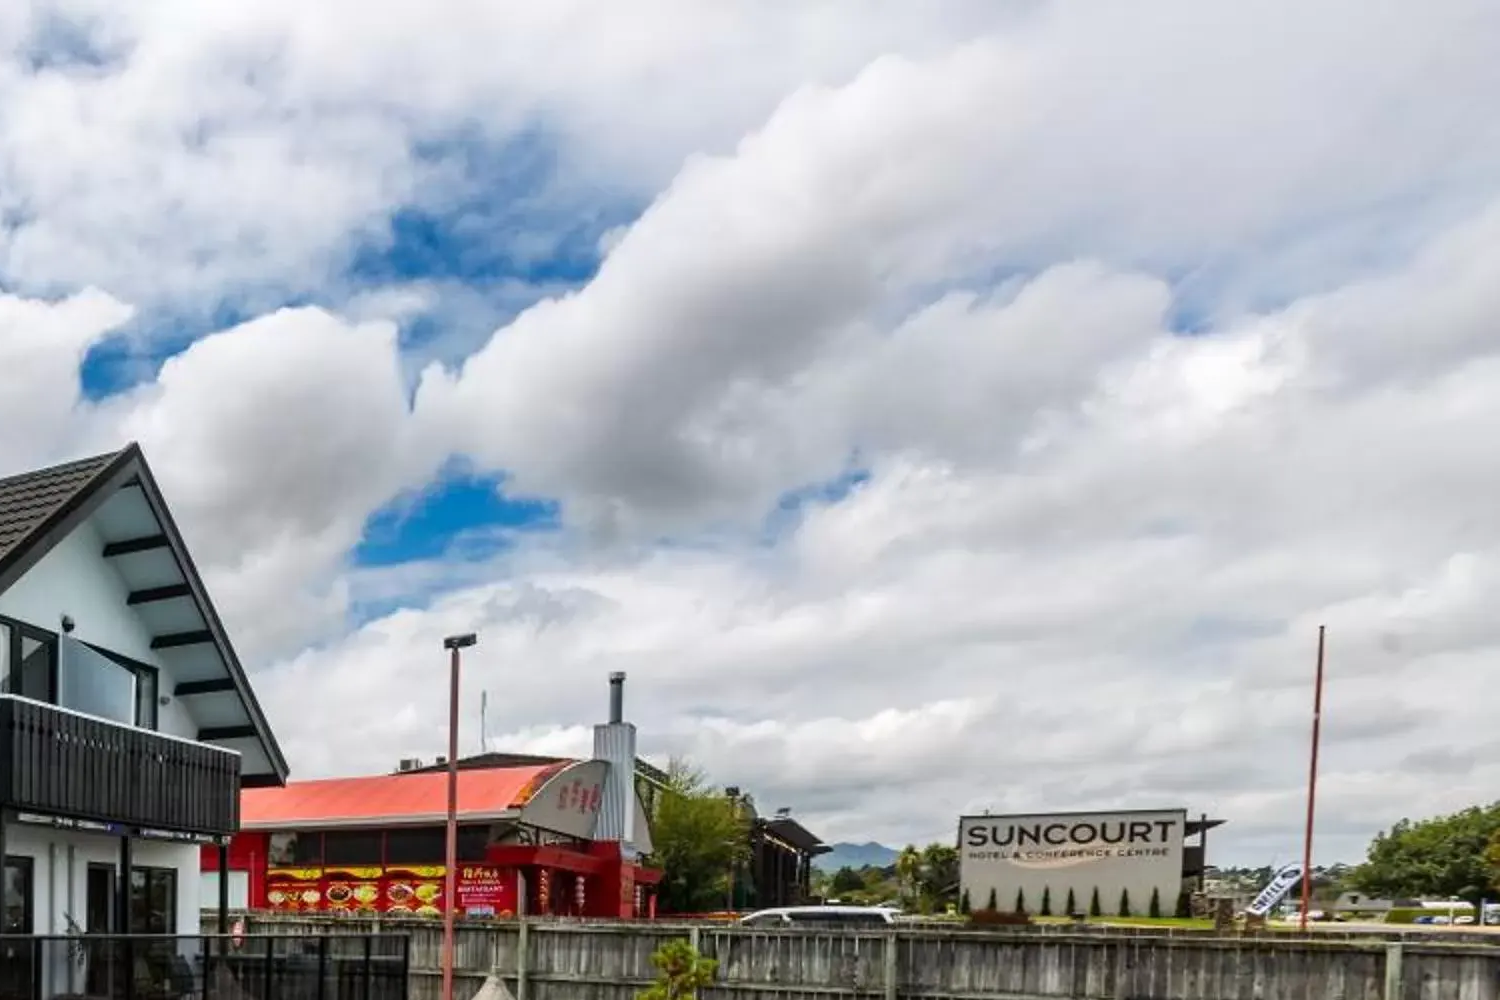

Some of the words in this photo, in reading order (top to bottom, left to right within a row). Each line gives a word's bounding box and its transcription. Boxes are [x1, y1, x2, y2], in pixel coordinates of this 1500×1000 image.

[967, 821, 1176, 847] SUNCOURT
[968, 851, 1008, 860] HOTEL
[1013, 851, 1020, 859] &
[1026, 849, 1112, 859] CONFERENCE
[1117, 847, 1169, 857] CENTRE
